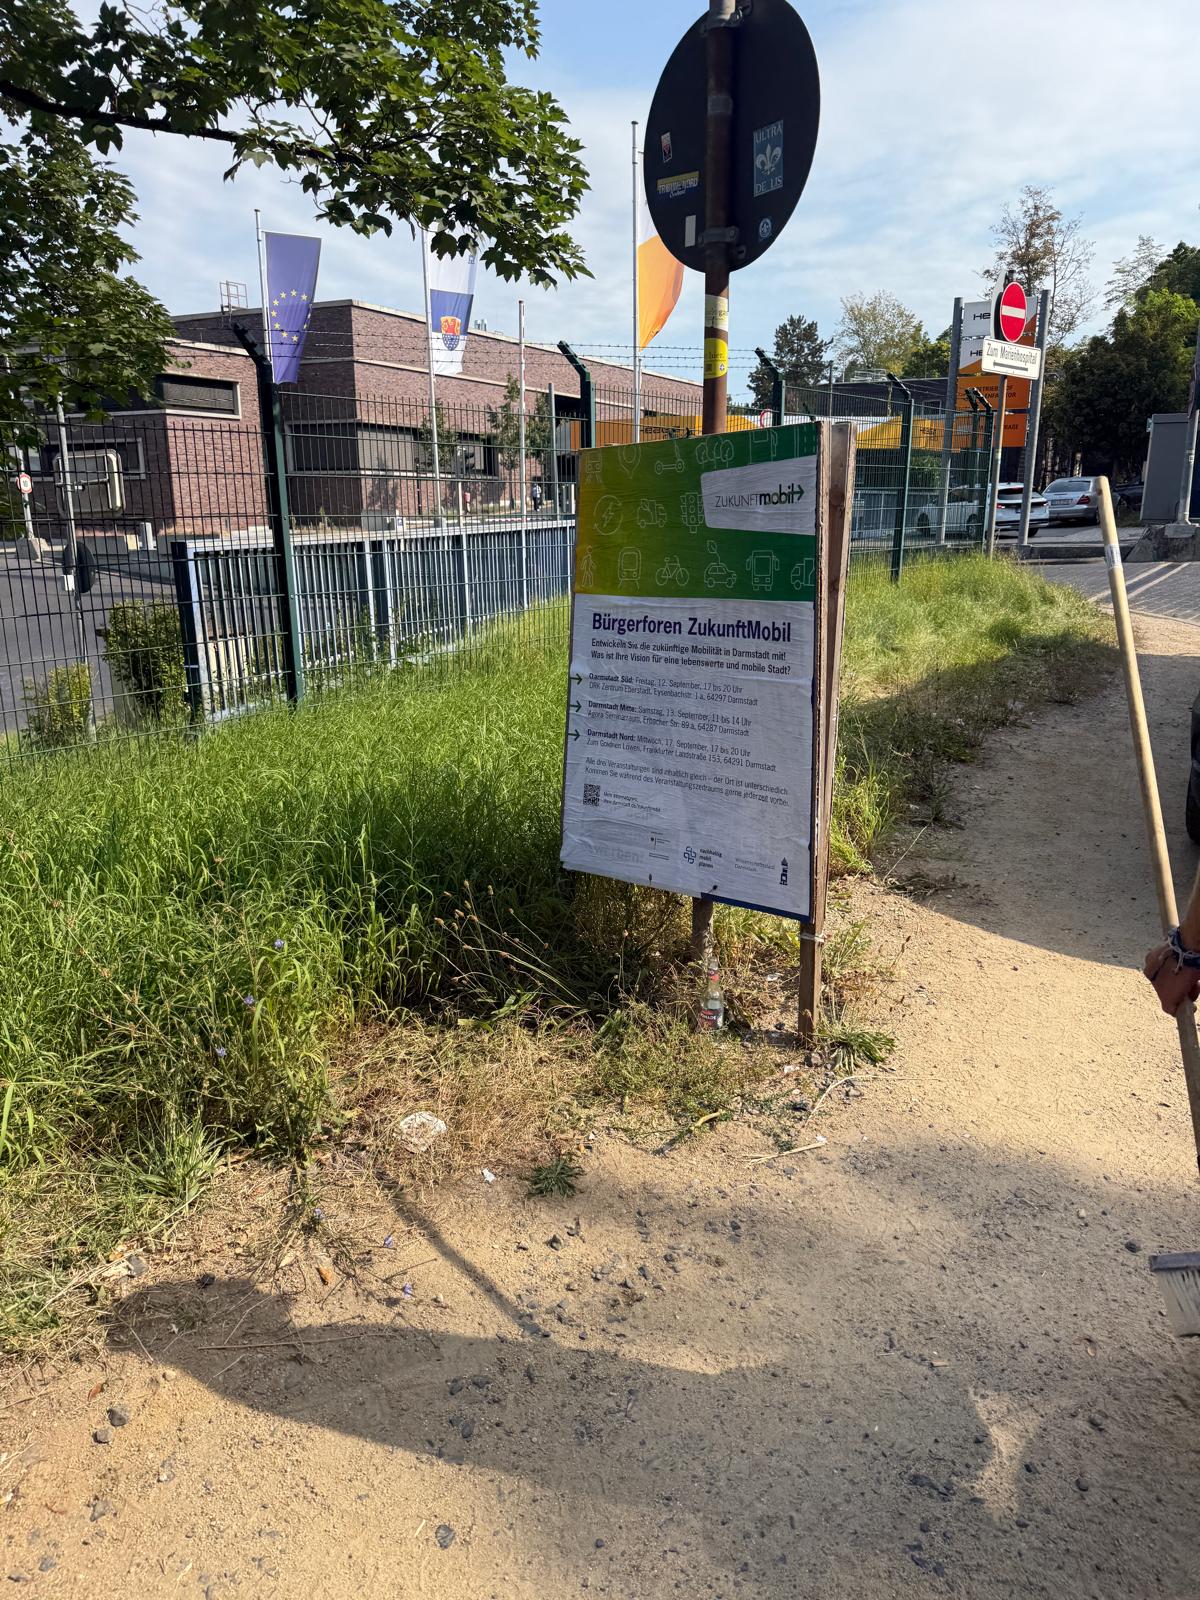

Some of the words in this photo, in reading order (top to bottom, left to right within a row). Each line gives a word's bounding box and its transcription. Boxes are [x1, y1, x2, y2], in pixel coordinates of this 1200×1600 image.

[755, 124, 782, 144] ULTRA
[755, 181, 767, 194] DE
[771, 176, 782, 188] LIS
[986, 343, 998, 358] Zum
[1000, 345, 1038, 366] Marienhospital
[592, 612, 682, 635] Bürgerforen
[687, 617, 791, 642] ZukunftMobil
[591, 639, 627, 648] Entwickeln
[628, 641, 637, 649] Sie
[640, 641, 651, 650] die
[652, 644, 689, 654] zukünftige
[691, 645, 722, 656] Mobilität
[723, 648, 730, 656] in
[732, 648, 769, 660] Darmstadt
[772, 652, 786, 661] mit!
[591, 651, 604, 659] Was
[606, 652, 614, 660] ist
[616, 652, 628, 661] Ihre
[630, 653, 650, 662] Vision
[652, 655, 662, 663] für
[664, 657, 679, 665] eine
[681, 658, 724, 668] lebenswerte
[726, 662, 739, 670] und
[742, 663, 766, 673] mobile
[768, 665, 791, 675] Stadt?
[589, 673, 619, 682] Darmstadt
[669, 680, 702, 690] September,
[704, 683, 712, 691] 17
[712, 684, 721, 692] bis
[722, 684, 731, 693] 20
[732, 685, 743, 693] Uhr
[602, 683, 623, 691] Zentrum
[707, 693, 727, 702] 64297
[727, 695, 758, 706] Darmstadt
[588, 701, 619, 710] Darmstadt
[620, 703, 636, 712] Mitte:
[638, 706, 664, 716] Samstag,
[677, 710, 710, 722] September,
[712, 714, 719, 722] 11
[721, 715, 730, 724] bis
[732, 716, 740, 725] 14
[741, 717, 752, 726] Uhr
[588, 710, 604, 719] Agora
[670, 719, 680, 728] Str.
[681, 721, 690, 729] 89
[697, 723, 717, 732] 64287
[718, 726, 749, 736] Darmstadt
[587, 729, 618, 739] Darmstadt
[619, 732, 635, 741] Nord:
[637, 735, 663, 746] Mittwoch,
[676, 740, 709, 752] September,
[711, 744, 719, 753] 17
[720, 746, 729, 755] bis
[730, 747, 739, 755] 20
[740, 748, 751, 757] Uhr
[587, 738, 599, 746] Zum
[643, 747, 674, 756] Frankfurter
[675, 750, 707, 761] Landstraße
[723, 757, 743, 767] 64291
[745, 760, 777, 772] Darmstadt
[585, 766, 608, 776] Kommen
[609, 769, 618, 777] Sie
[619, 771, 641, 782] während
[643, 775, 653, 783] des
[586, 757, 595, 765] Alle
[596, 758, 607, 767] drei
[607, 760, 650, 774] Veranstaltungen
[652, 767, 663, 775] sind
[690, 772, 706, 781] gleich
[713, 776, 723, 784] der
[725, 777, 735, 785] Ort
